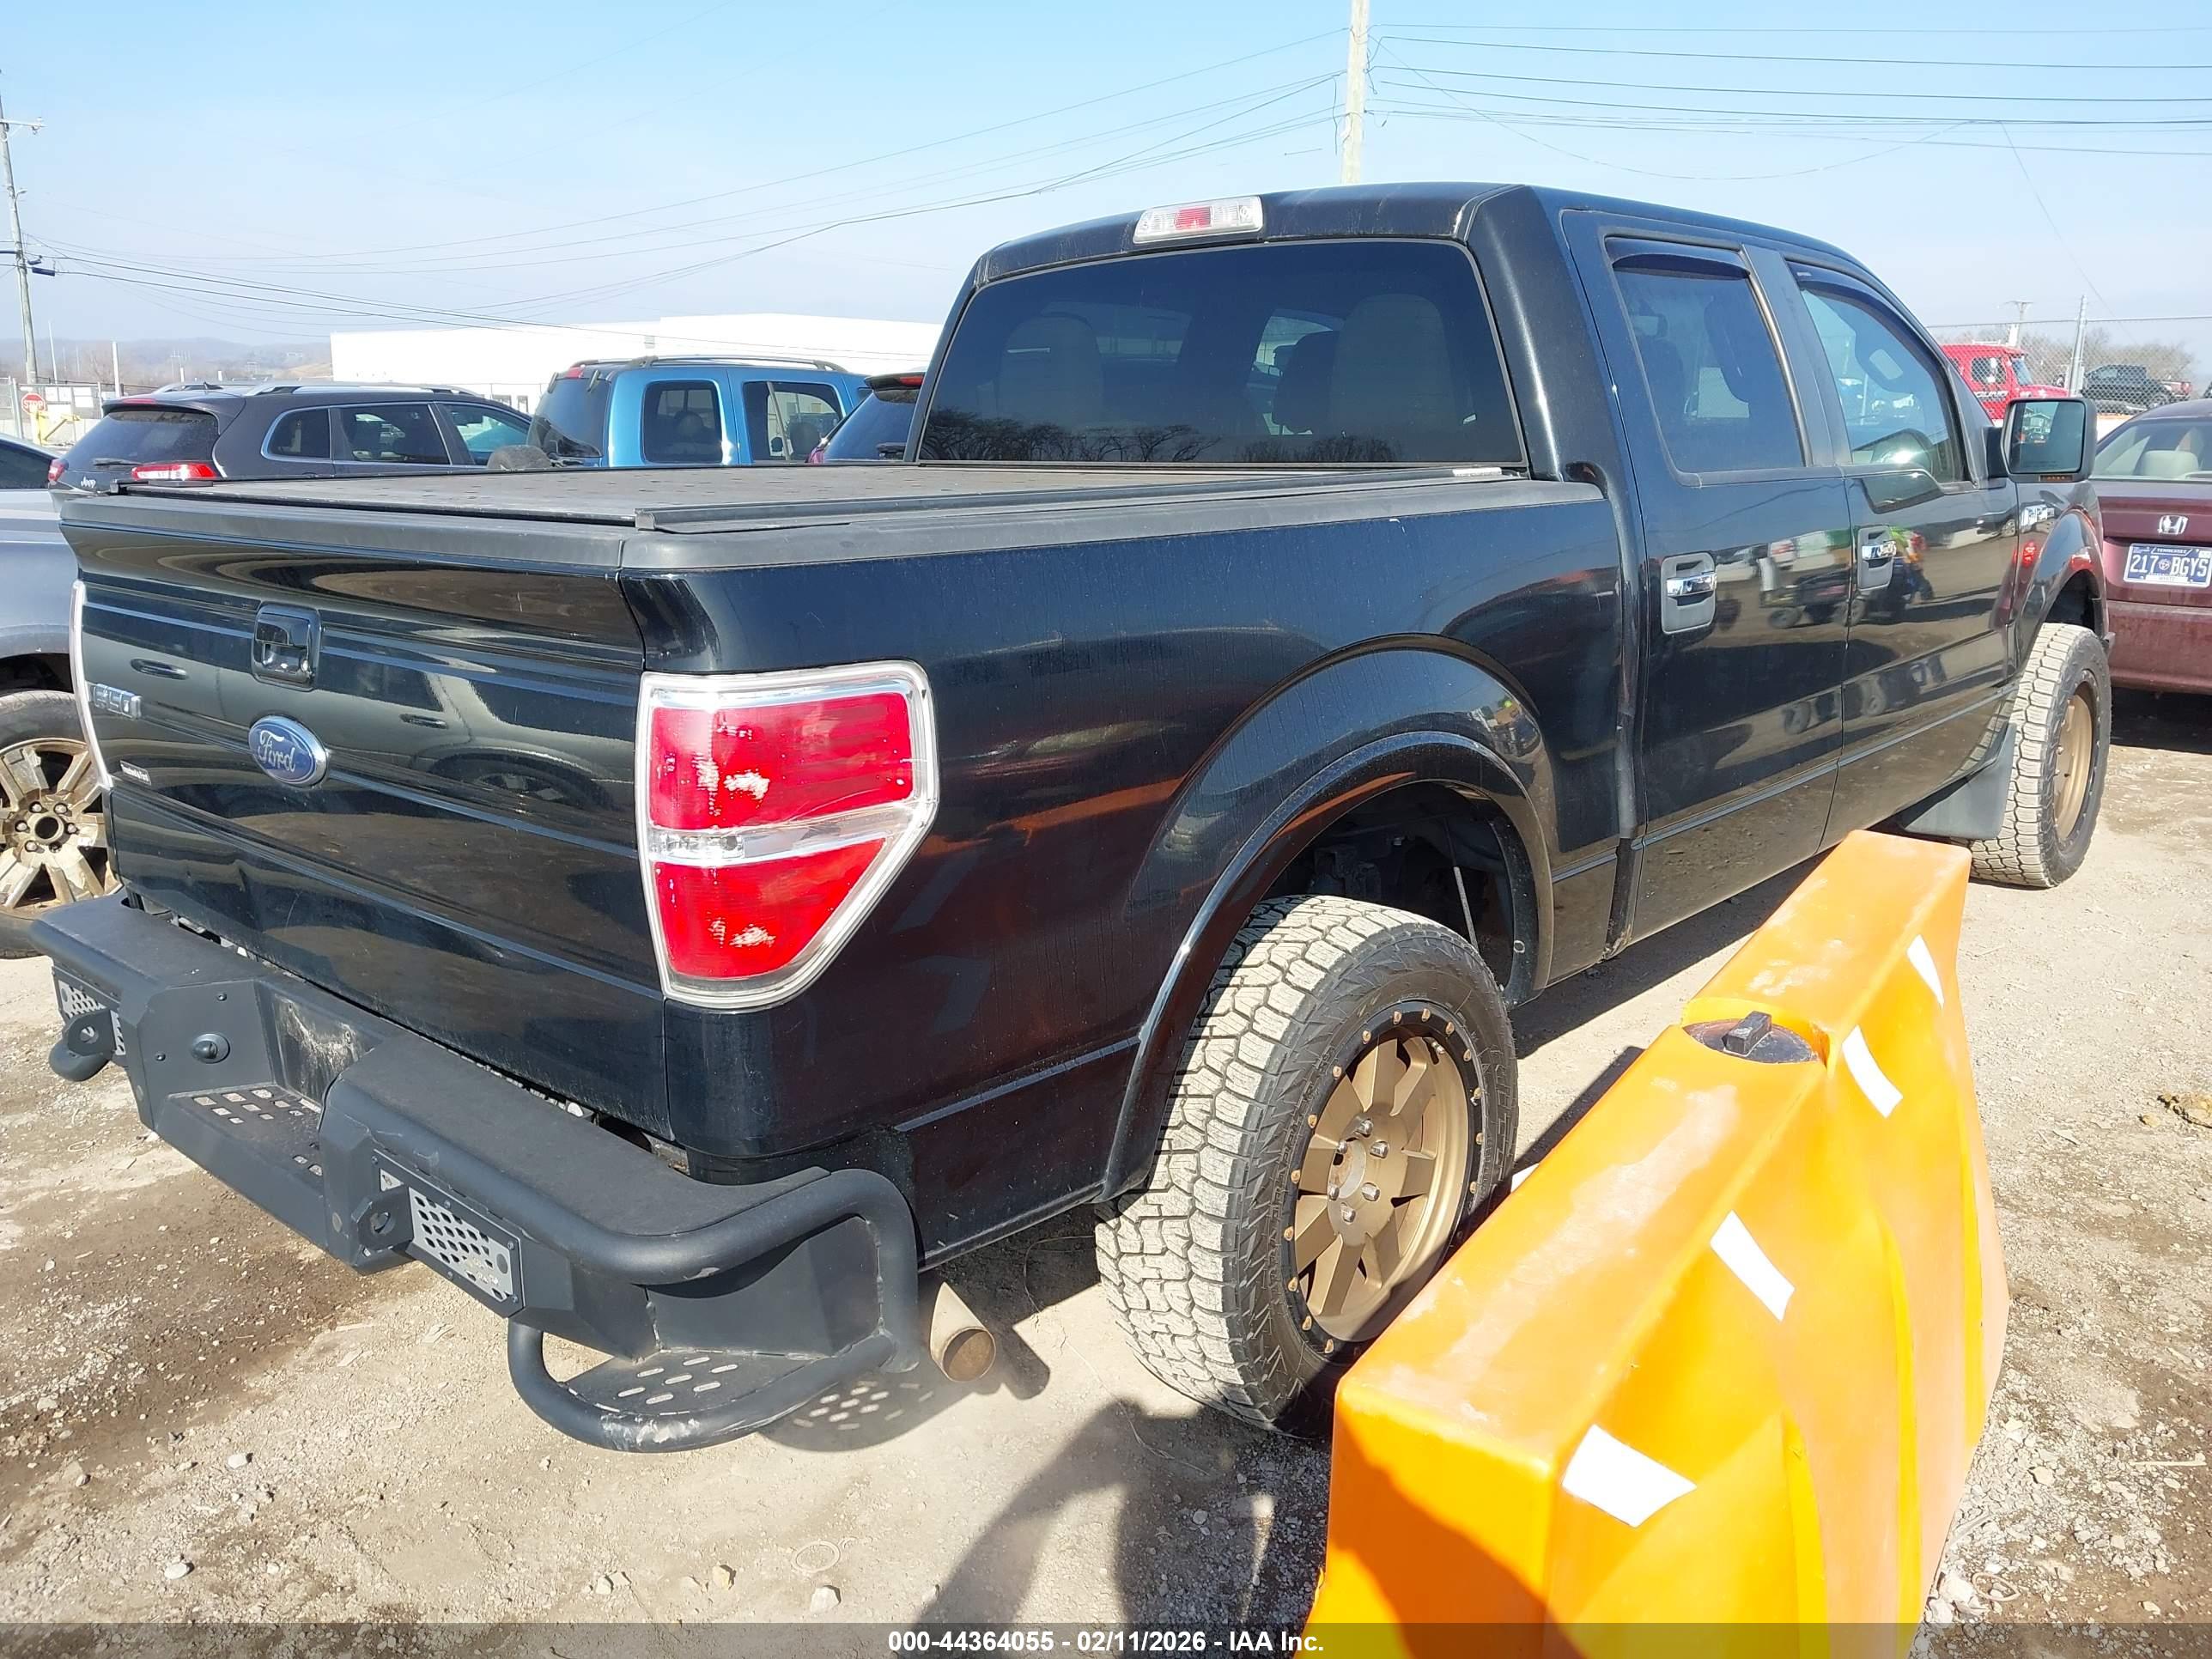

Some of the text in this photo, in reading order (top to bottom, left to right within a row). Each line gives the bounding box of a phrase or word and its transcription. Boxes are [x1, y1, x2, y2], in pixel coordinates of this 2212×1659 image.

[24, 399, 44, 410] STOP
[2130, 555, 2159, 574] 217
[258, 730, 296, 772] Ford
